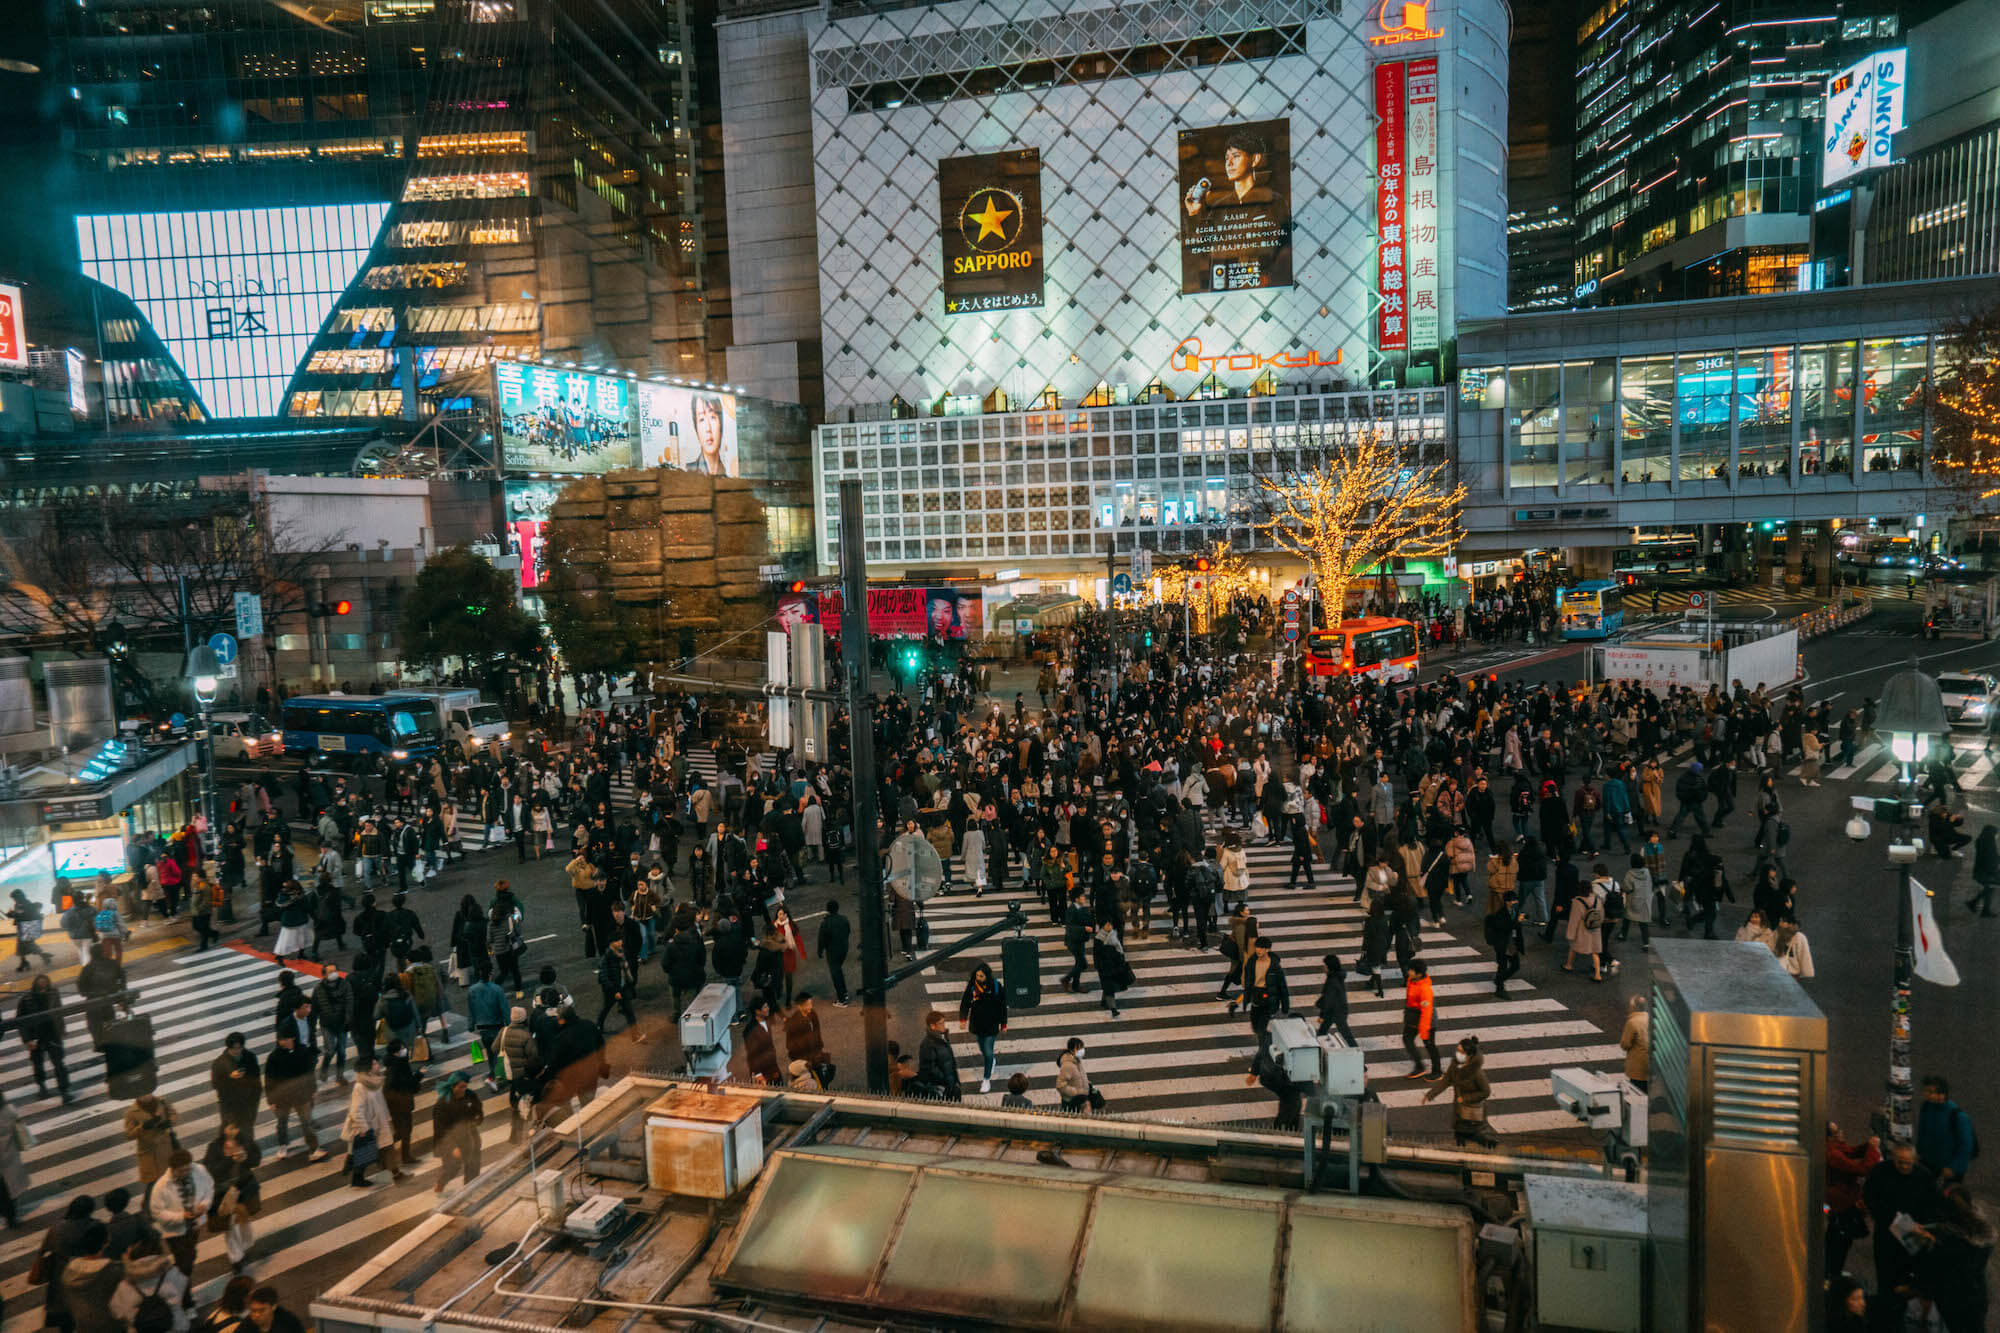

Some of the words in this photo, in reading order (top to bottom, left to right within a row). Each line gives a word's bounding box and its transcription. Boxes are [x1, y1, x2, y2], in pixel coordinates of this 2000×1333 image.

[1369, 28, 1445, 46] TOKYU
[1827, 72, 1871, 152] SANKYO
[1874, 61, 1901, 157] SANKYO
[1411, 155, 1437, 311] 島根物産展
[953, 251, 1032, 274] SAPPORO
[1575, 279, 1597, 298] GMO
[958, 293, 1043, 312] 大人をはじめよう。
[207, 307, 268, 340] 日本
[1199, 348, 1342, 372] TOKYU
